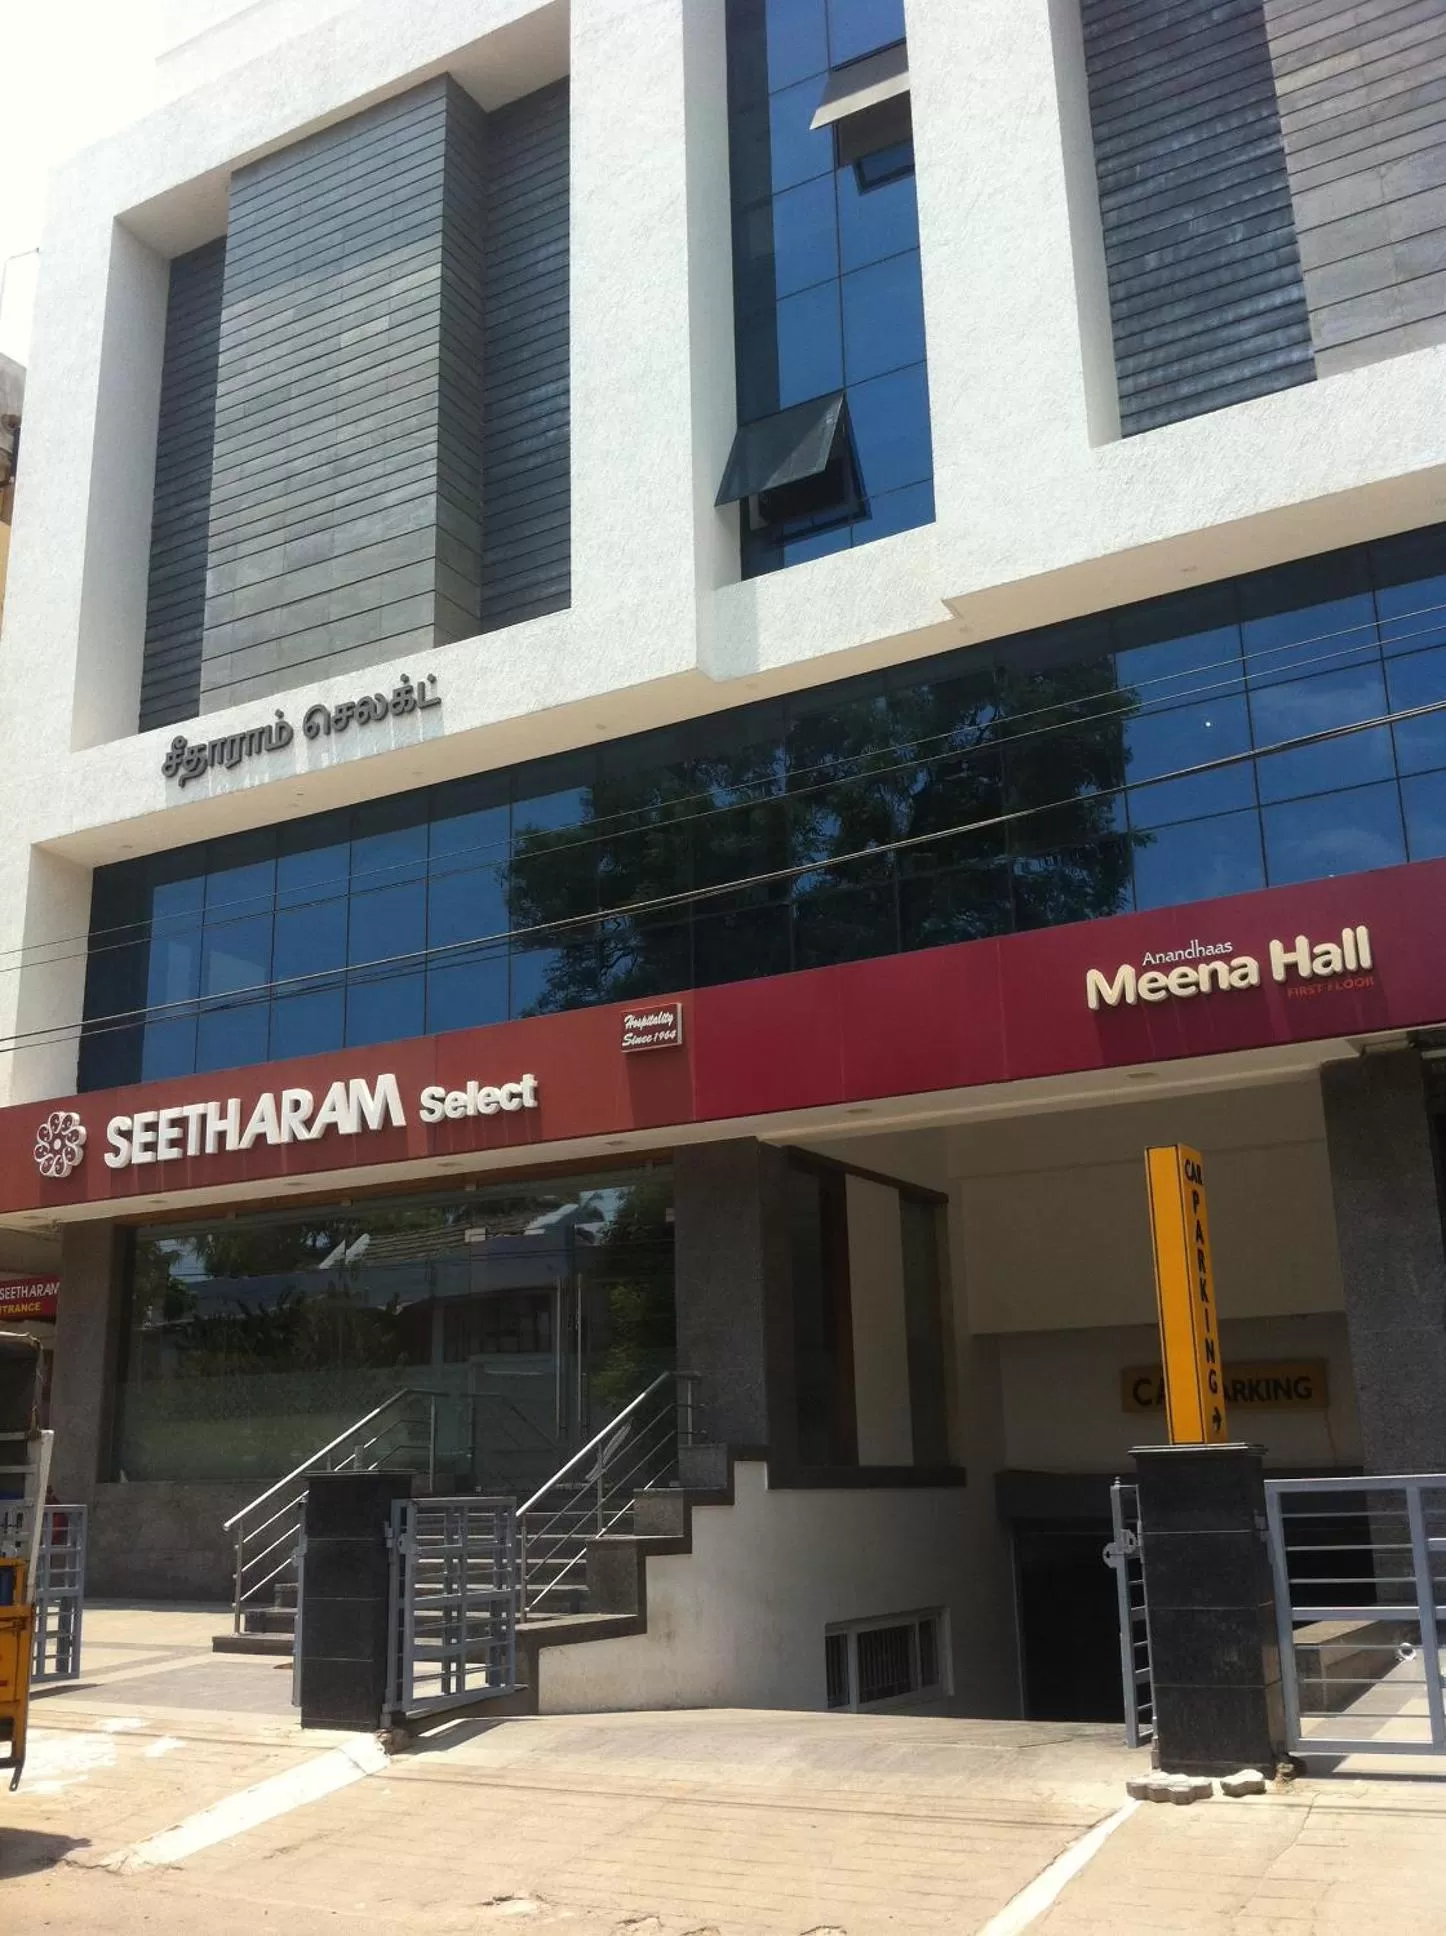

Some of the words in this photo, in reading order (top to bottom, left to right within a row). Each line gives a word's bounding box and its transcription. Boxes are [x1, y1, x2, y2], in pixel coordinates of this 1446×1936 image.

[161, 708, 294, 788] சீதாராம்
[302, 673, 442, 741] செலக்ட்
[1141, 939, 1234, 966] Anandhaas
[1086, 955, 1261, 1010] Meena
[1269, 925, 1374, 983] Hall
[1286, 983, 1324, 999] FIRST
[624, 1011, 673, 1030] Hospitality
[622, 1032, 652, 1046] Since
[653, 1030, 676, 1042] 1964
[104, 1072, 405, 1169] SEETHARAM
[419, 1073, 539, 1124] Select
[1192, 1190, 1219, 1395] PARKING
[1223, 1376, 1313, 1403] RKING
